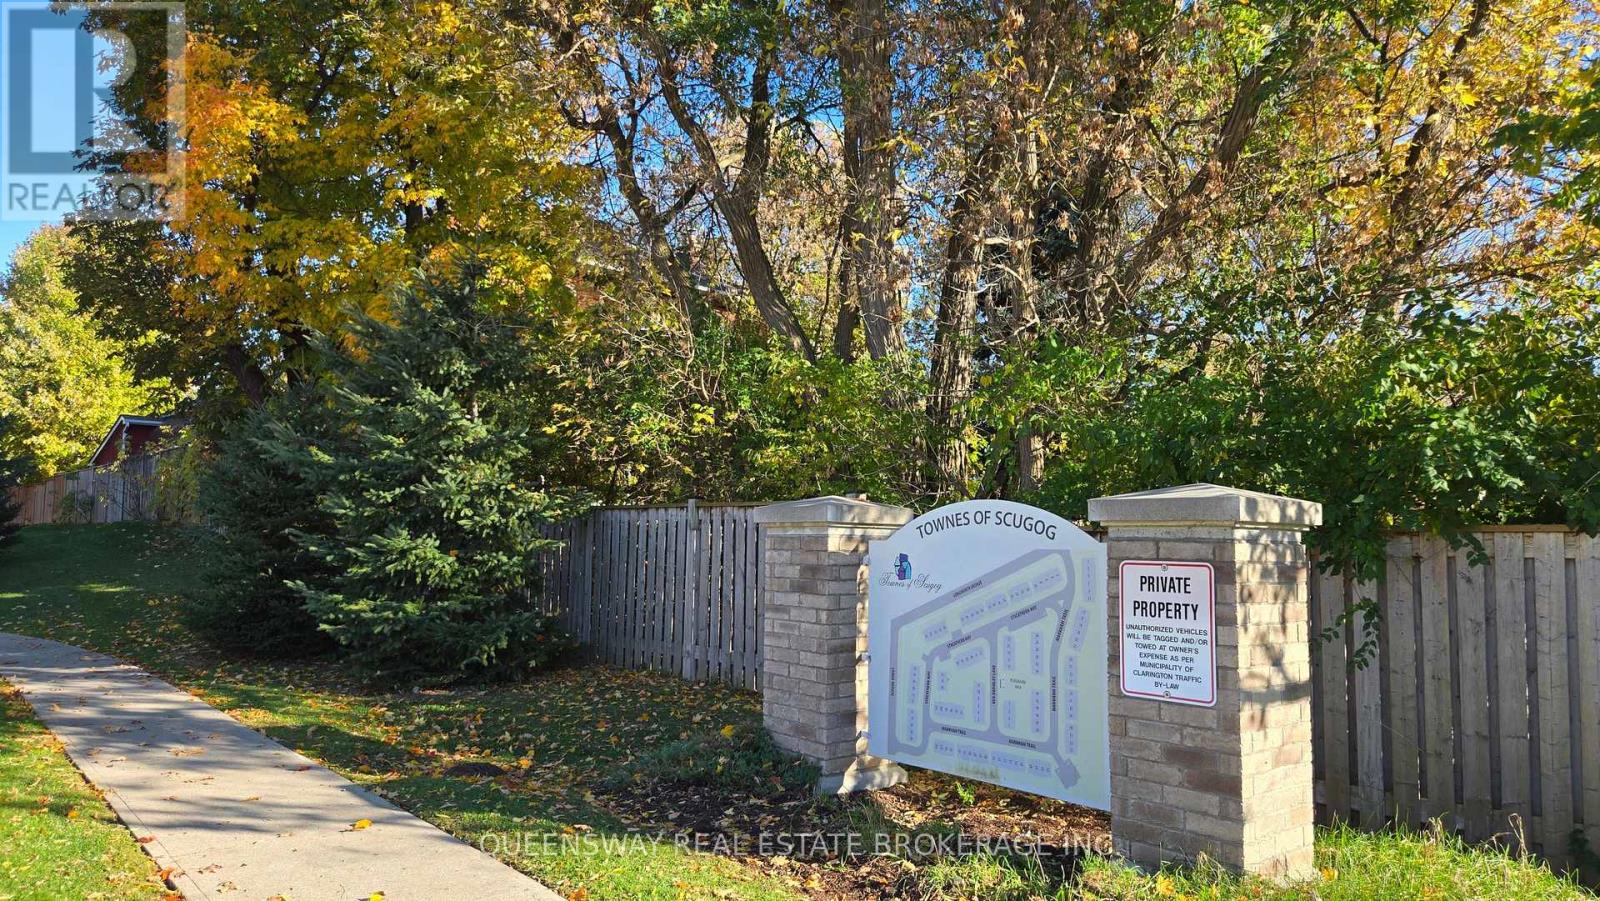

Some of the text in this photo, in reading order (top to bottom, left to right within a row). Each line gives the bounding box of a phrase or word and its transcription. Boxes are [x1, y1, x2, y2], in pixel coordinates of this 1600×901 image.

[916, 510, 1057, 540] TOWNES OF SCUGOG
[1140, 575, 1191, 594] PRIVATE
[1133, 600, 1199, 620] PROPERTY
[1126, 624, 1208, 636] UNAUTHORIZED VEHICLES
[1154, 635, 1178, 643] TAGGED
[1135, 642, 1157, 650] TOWED
[1169, 646, 1199, 655] OWNER'S
[1139, 652, 1168, 661] EXPENSE
[1181, 656, 1194, 664] PER
[1139, 661, 1182, 672] MUNICIPALITY
[1133, 670, 1202, 684] CLARINGTON TRAFFIC
[1154, 681, 1180, 690] BY-LAW
